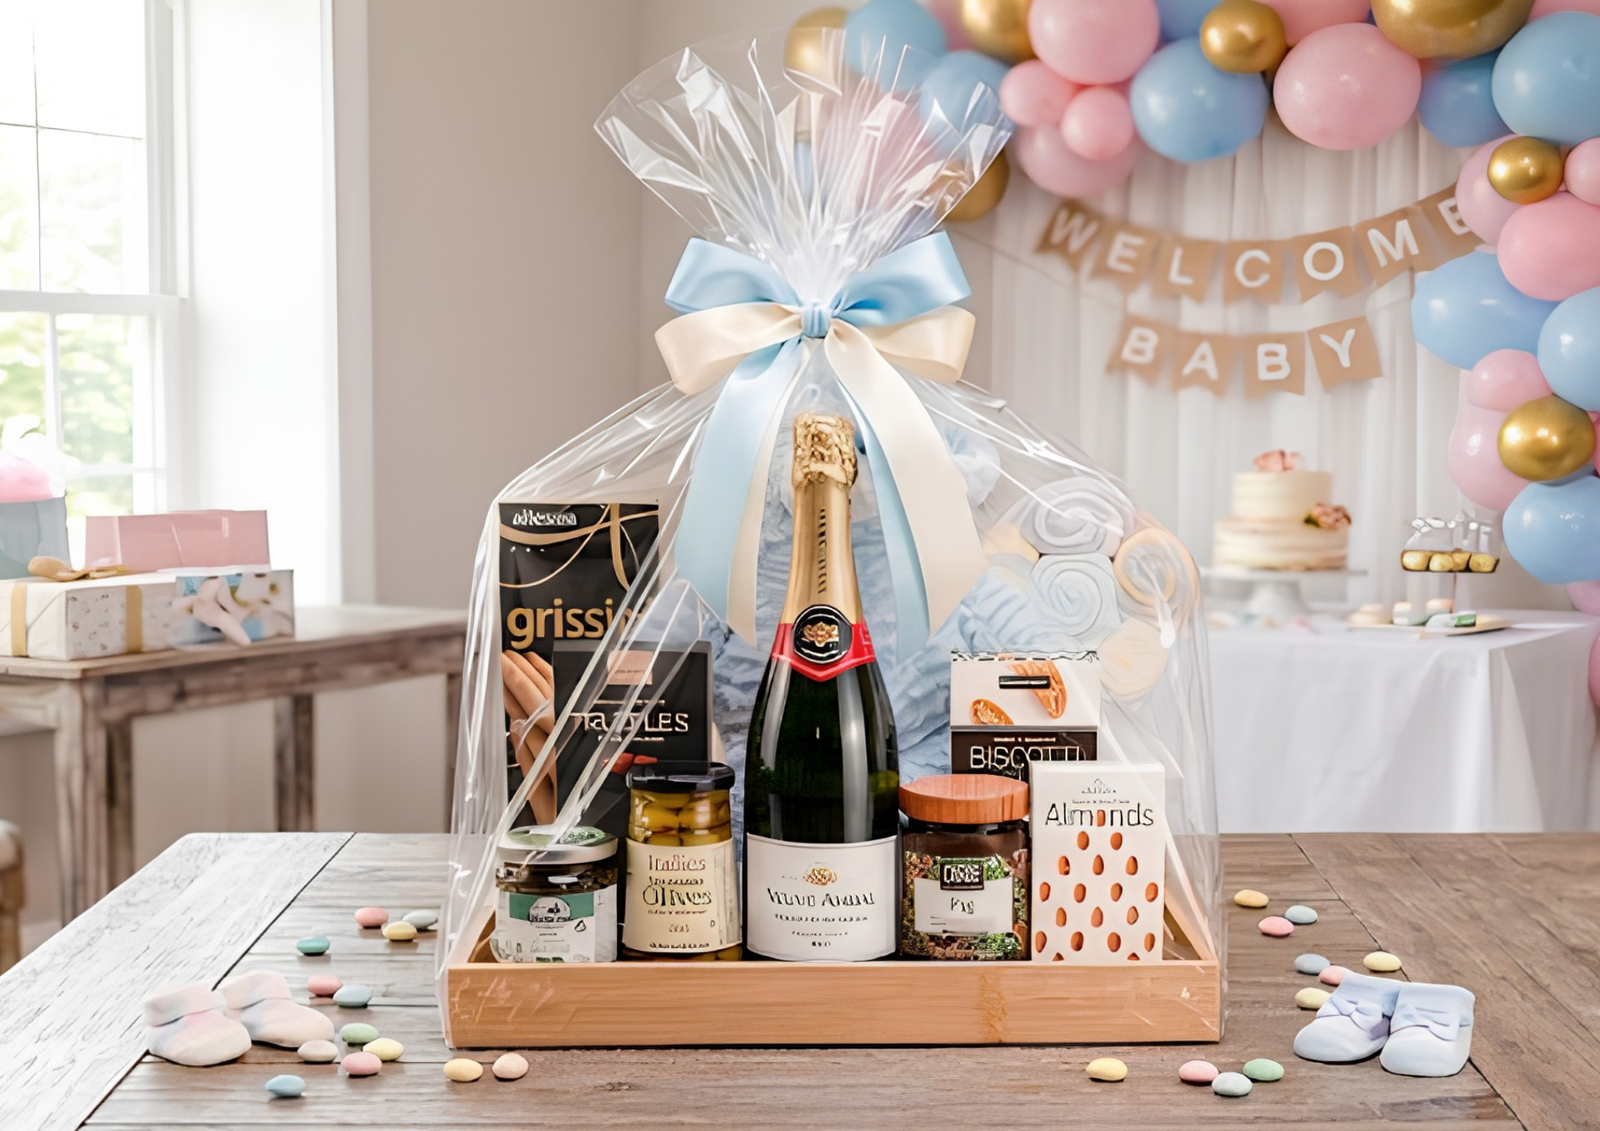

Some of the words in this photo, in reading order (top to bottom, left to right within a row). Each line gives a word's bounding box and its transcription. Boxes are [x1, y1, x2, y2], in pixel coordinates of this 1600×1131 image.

[1050, 196, 1471, 288] WELCOME
[1120, 325, 1357, 381] BABY
[506, 598, 654, 650] grissin
